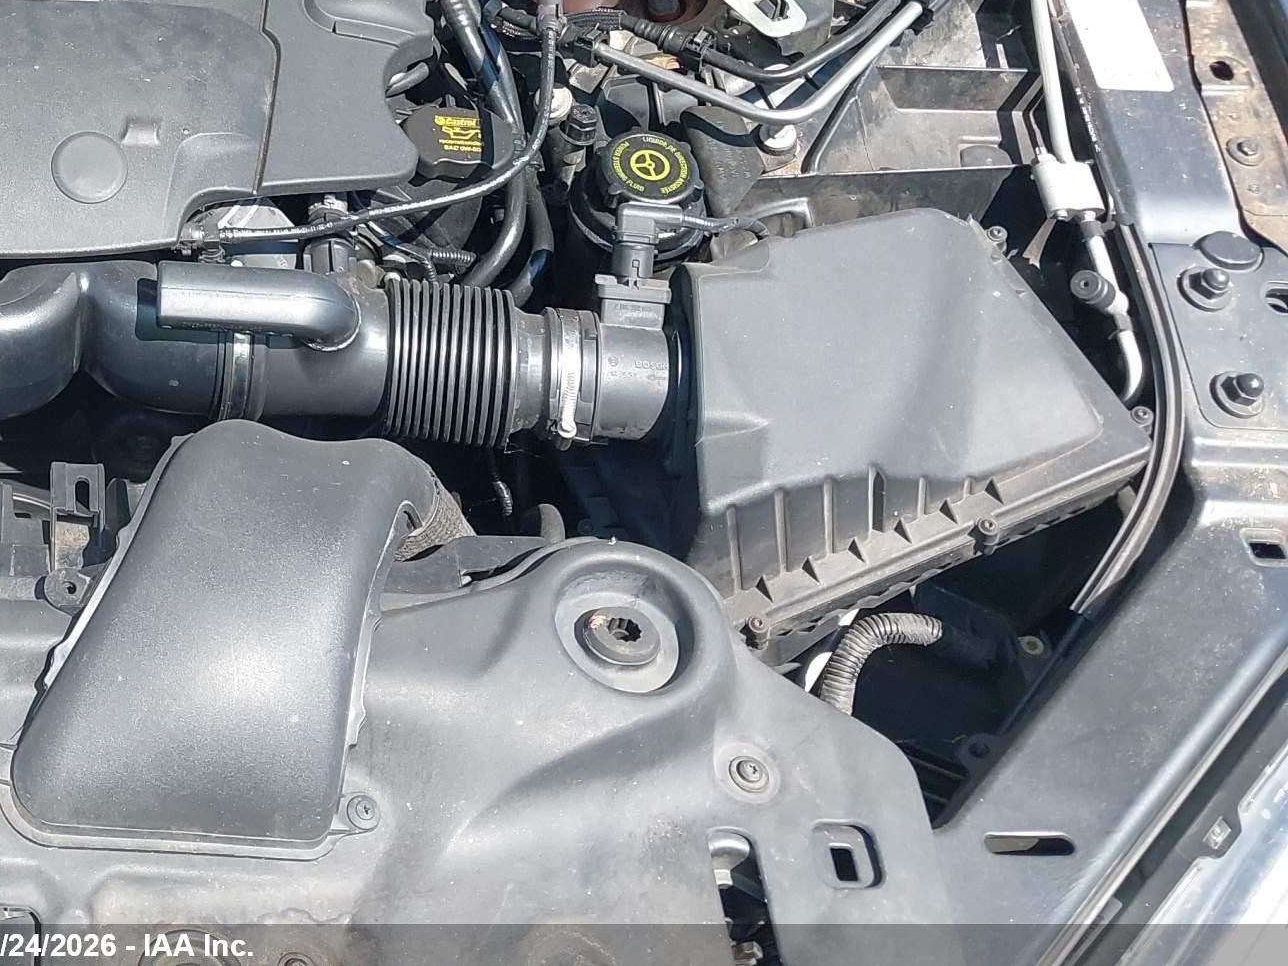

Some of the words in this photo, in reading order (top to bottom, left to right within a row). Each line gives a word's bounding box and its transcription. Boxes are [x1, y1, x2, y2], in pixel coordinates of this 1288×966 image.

[613, 141, 630, 157] POWER
[612, 156, 628, 181] STEERING
[626, 180, 645, 192] FLUID
